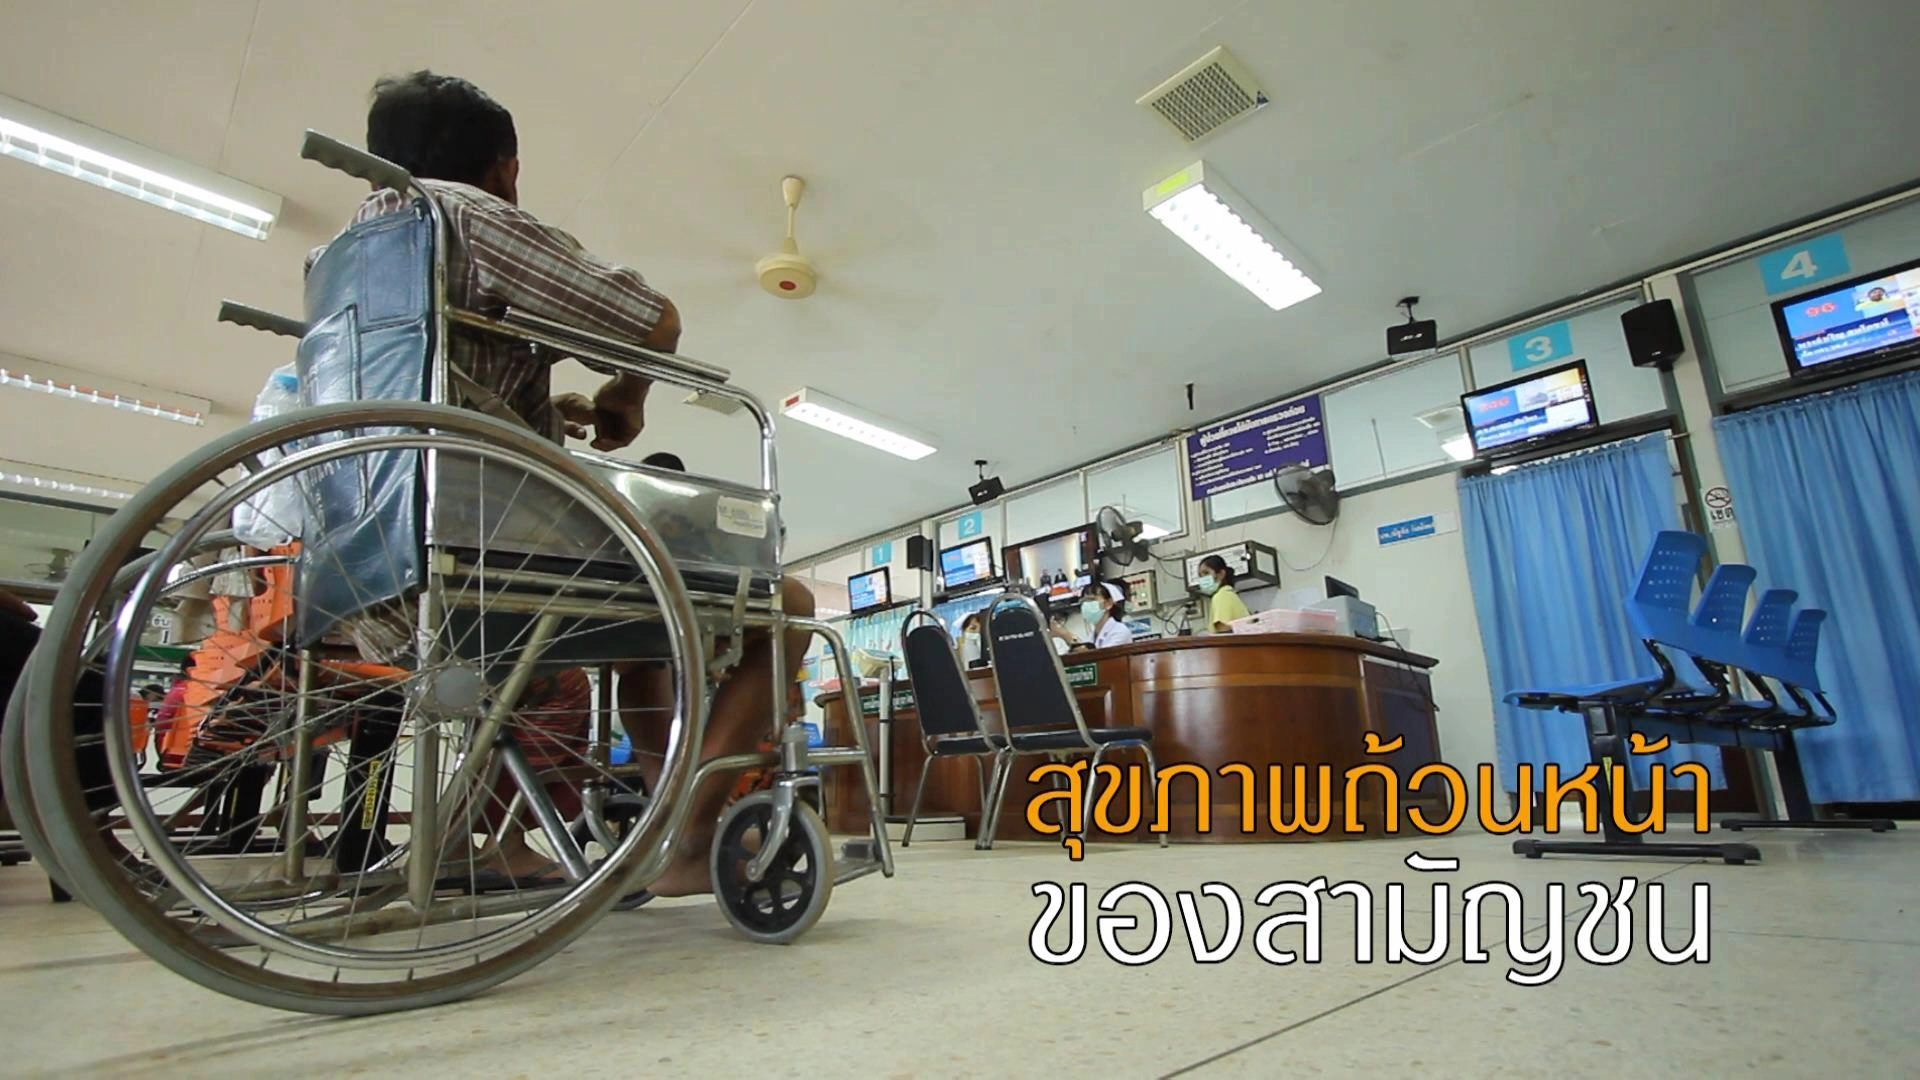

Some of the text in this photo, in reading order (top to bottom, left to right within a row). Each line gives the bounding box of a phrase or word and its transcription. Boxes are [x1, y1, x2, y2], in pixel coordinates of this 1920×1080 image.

[1781, 249, 1817, 280] 4
[1525, 336, 1552, 361] 3
[963, 520, 976, 534] 2
[878, 546, 884, 561] 1
